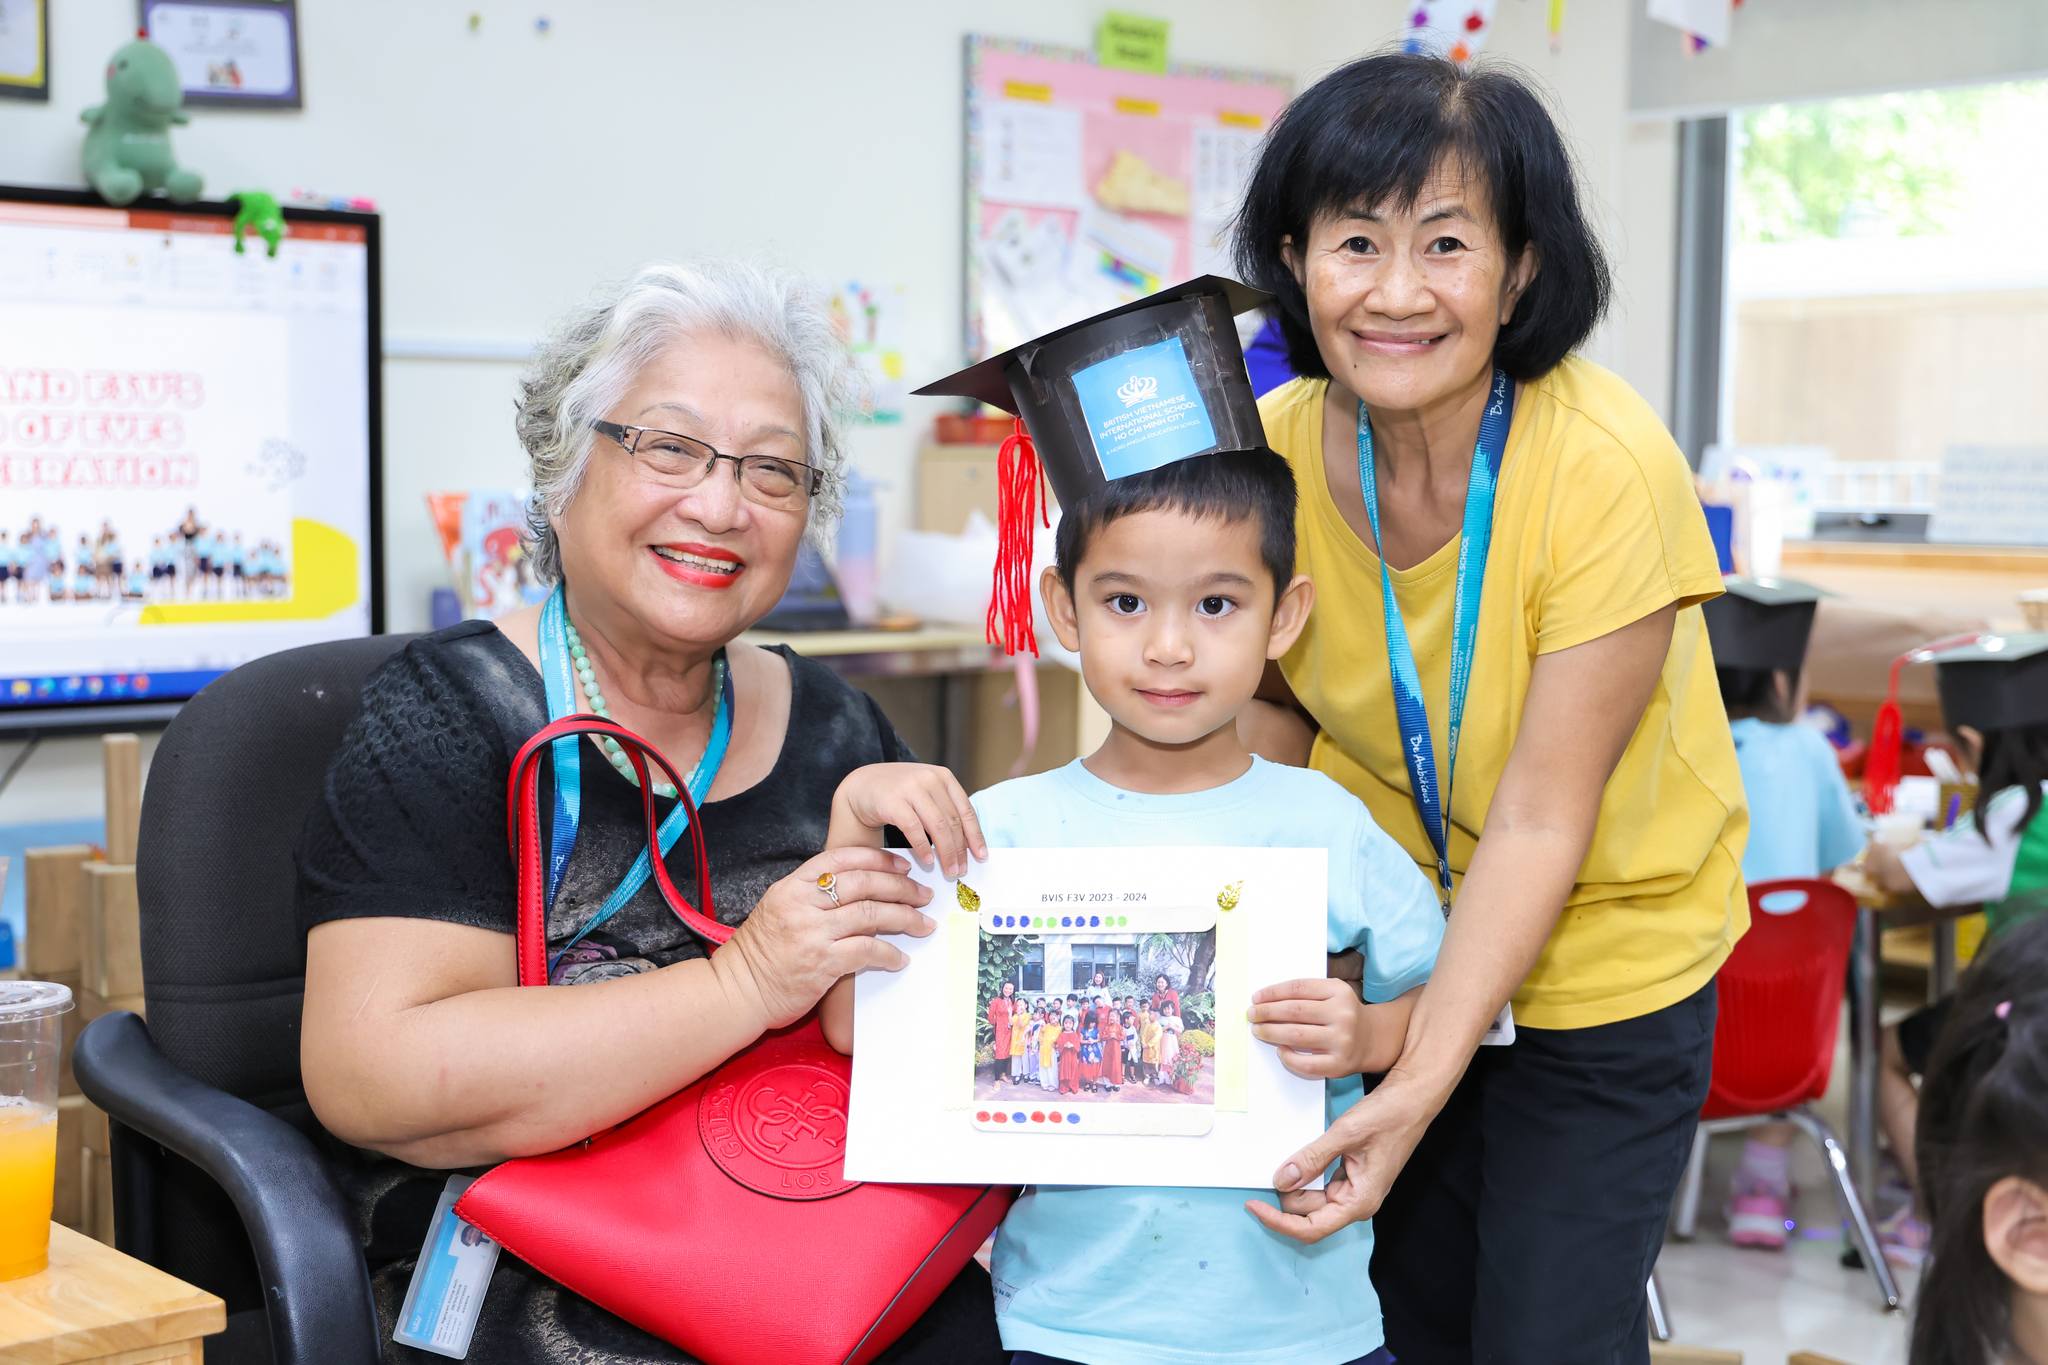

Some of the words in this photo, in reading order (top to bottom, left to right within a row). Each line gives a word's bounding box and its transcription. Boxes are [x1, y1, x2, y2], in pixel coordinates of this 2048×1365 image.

[1099, 410, 1162, 439] INTERNATIONAL
[1164, 400, 1197, 414] SCHOOL
[1103, 411, 1132, 428] BRITISH
[1134, 394, 1185, 415] VIETNAMESE
[1490, 399, 1503, 416] Be
[1114, 431, 1127, 441] HO
[1127, 426, 1142, 436] CHI
[1143, 417, 1166, 430] MINH
[1167, 412, 1183, 422] CITY
[1453, 571, 1464, 636] INTERNATIONAL
[1459, 536, 1469, 570] SCHOOL
[1412, 754, 1430, 803] Ambitious
[1041, 893, 1064, 902] BVIS
[1067, 893, 1086, 902] F3V
[1089, 893, 1113, 902] 2023
[1123, 892, 1147, 902] 2024
[709, 1083, 744, 1159] GUESS
[781, 1170, 832, 1189] LOS
